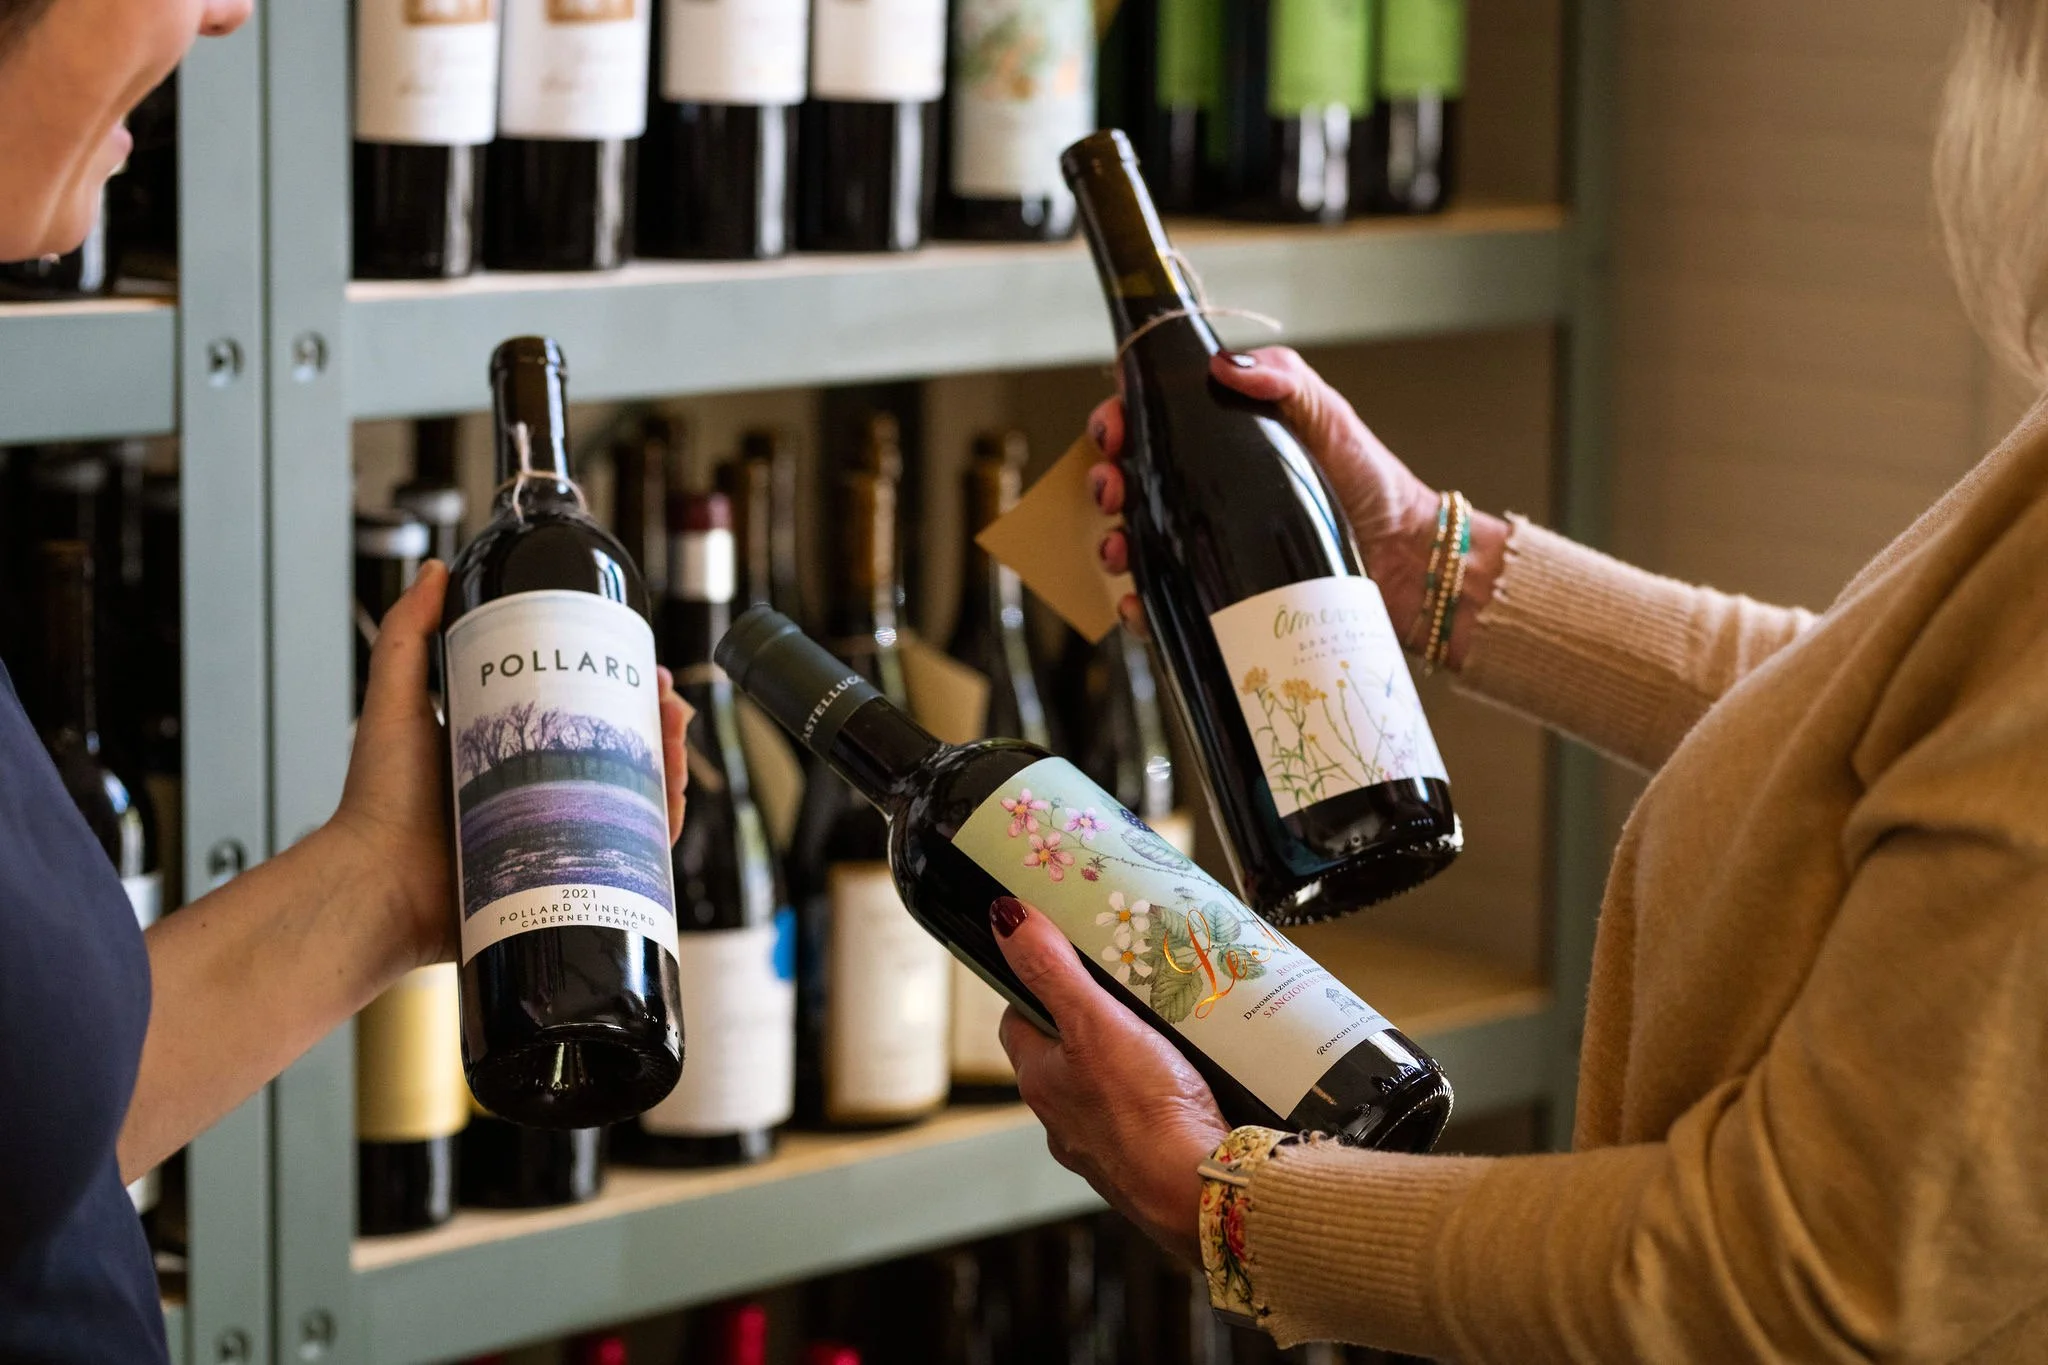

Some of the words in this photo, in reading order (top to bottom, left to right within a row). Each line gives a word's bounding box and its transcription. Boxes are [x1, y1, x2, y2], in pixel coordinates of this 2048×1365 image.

[481, 649, 641, 688] POLLARD
[562, 888, 597, 900] 2021
[500, 902, 572, 926] POLLARD
[522, 913, 590, 929] CABERNET
[583, 902, 656, 927] VINEYARD
[598, 915, 639, 930] FRANC
